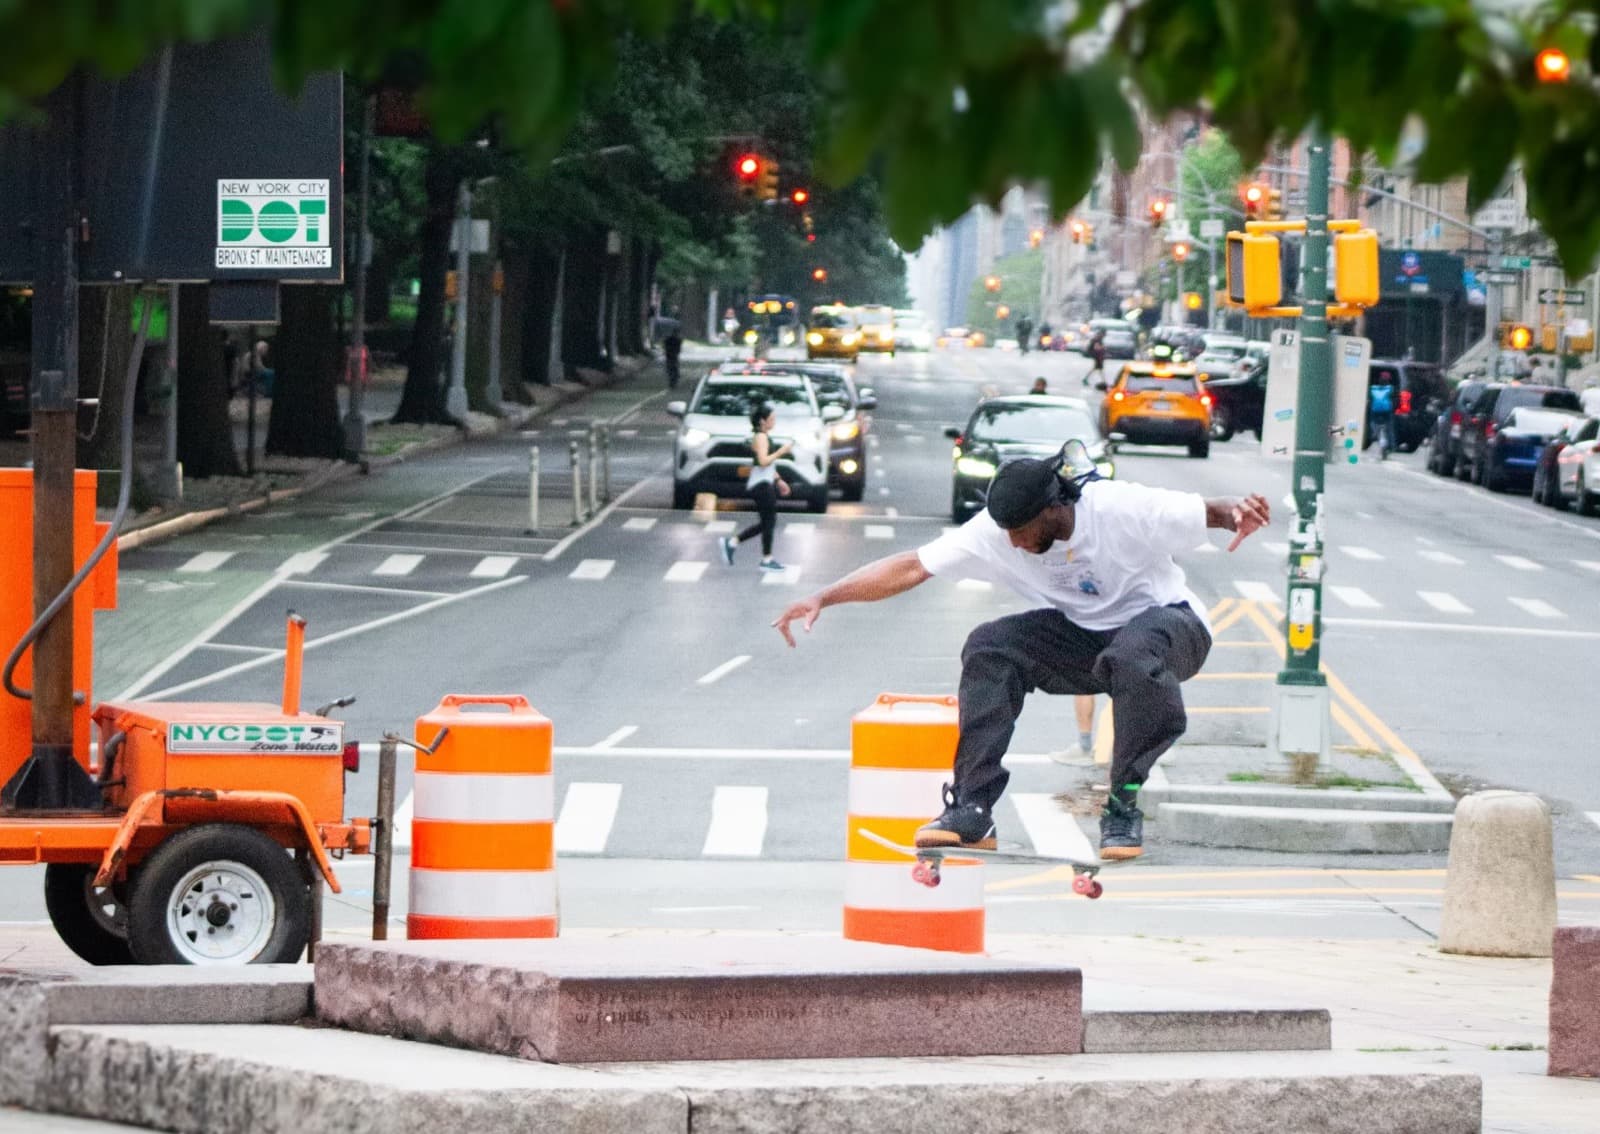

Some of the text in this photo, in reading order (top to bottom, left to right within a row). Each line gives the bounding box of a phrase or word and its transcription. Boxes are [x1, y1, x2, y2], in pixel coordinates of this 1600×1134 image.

[222, 183, 325, 193] NEW YORK CITY
[222, 200, 326, 243] DOT
[218, 250, 326, 265] BRONX ST. MAINTENANCE
[250, 741, 338, 752] Zone Watch
